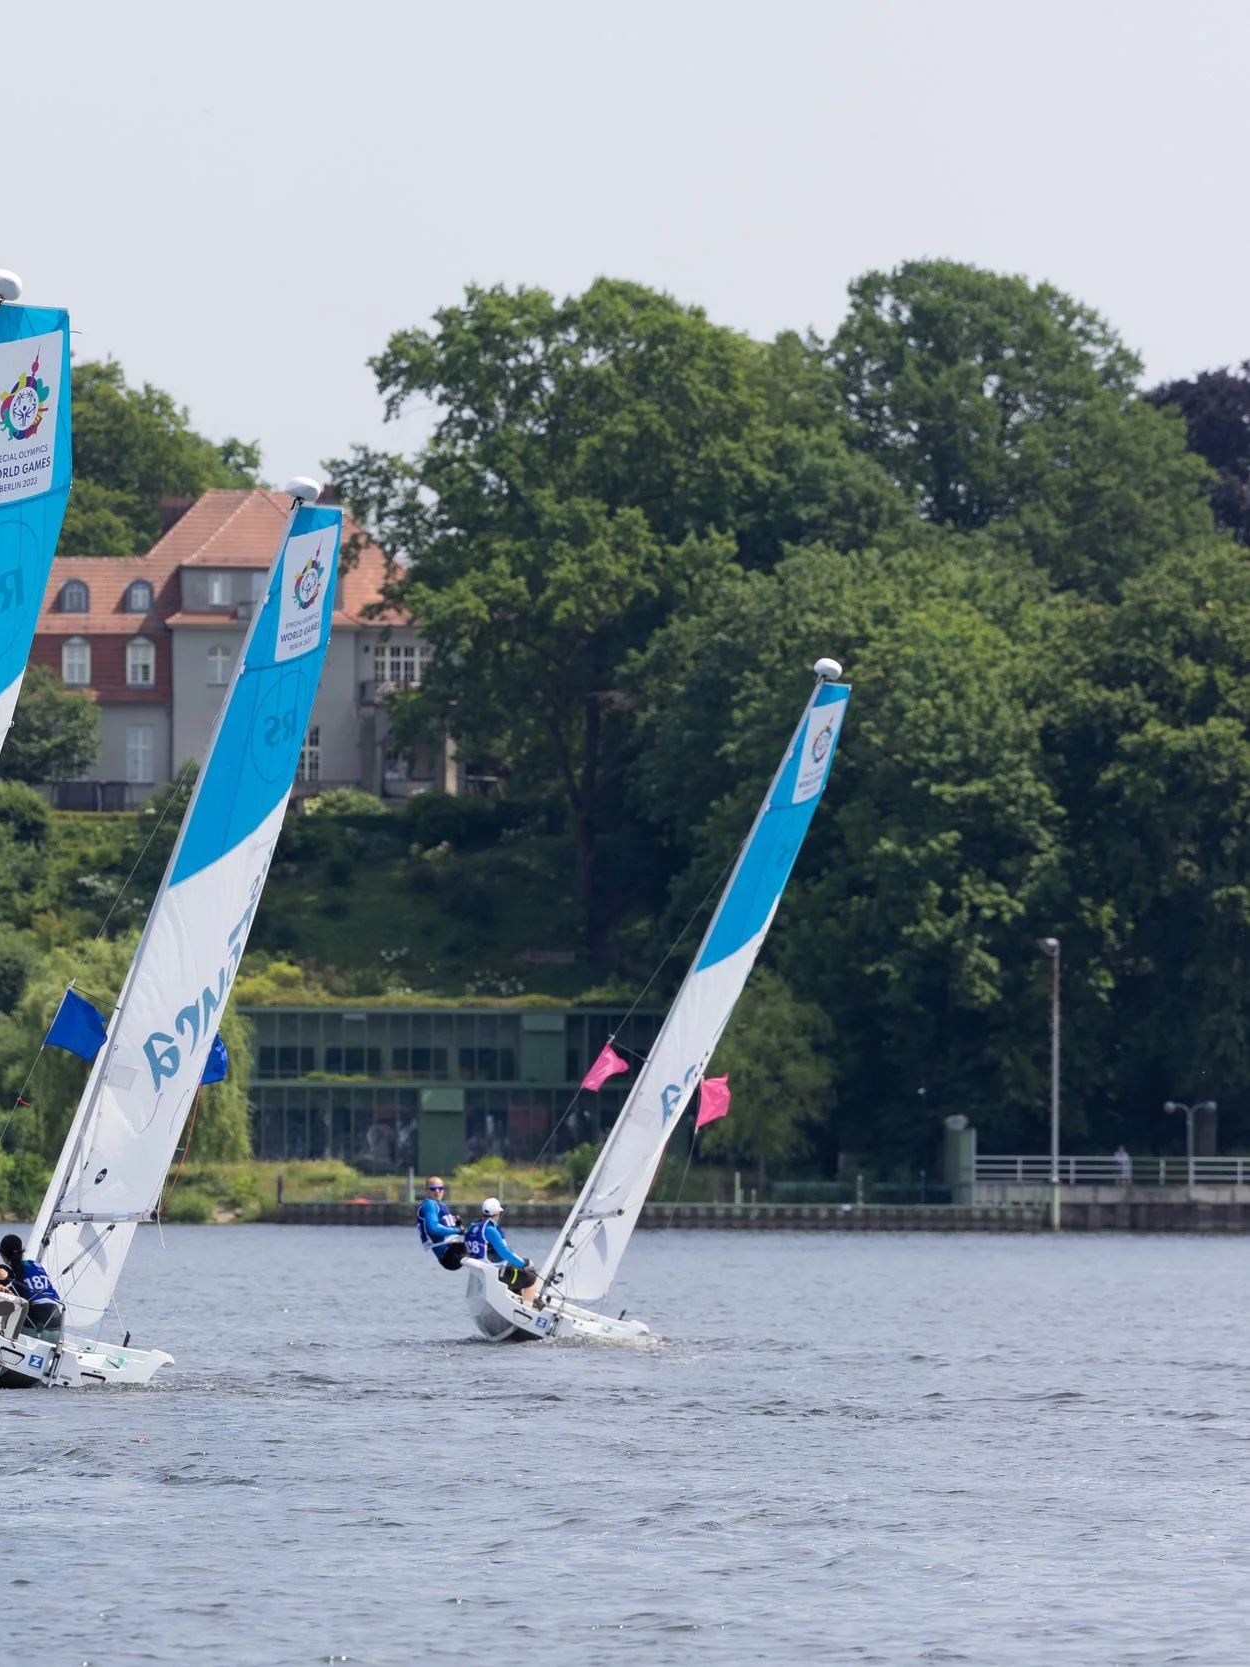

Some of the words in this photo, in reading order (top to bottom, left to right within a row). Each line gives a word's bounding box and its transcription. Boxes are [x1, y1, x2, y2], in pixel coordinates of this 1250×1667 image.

[19, 444, 48, 459] OLYMPICS
[22, 456, 51, 476] GAMES
[0, 481, 22, 493] BERLIN
[22, 477, 38, 489] 2023
[281, 629, 303, 642] WORLD
[304, 621, 320, 636] GAMES
[23, 1274, 51, 1290] 187
